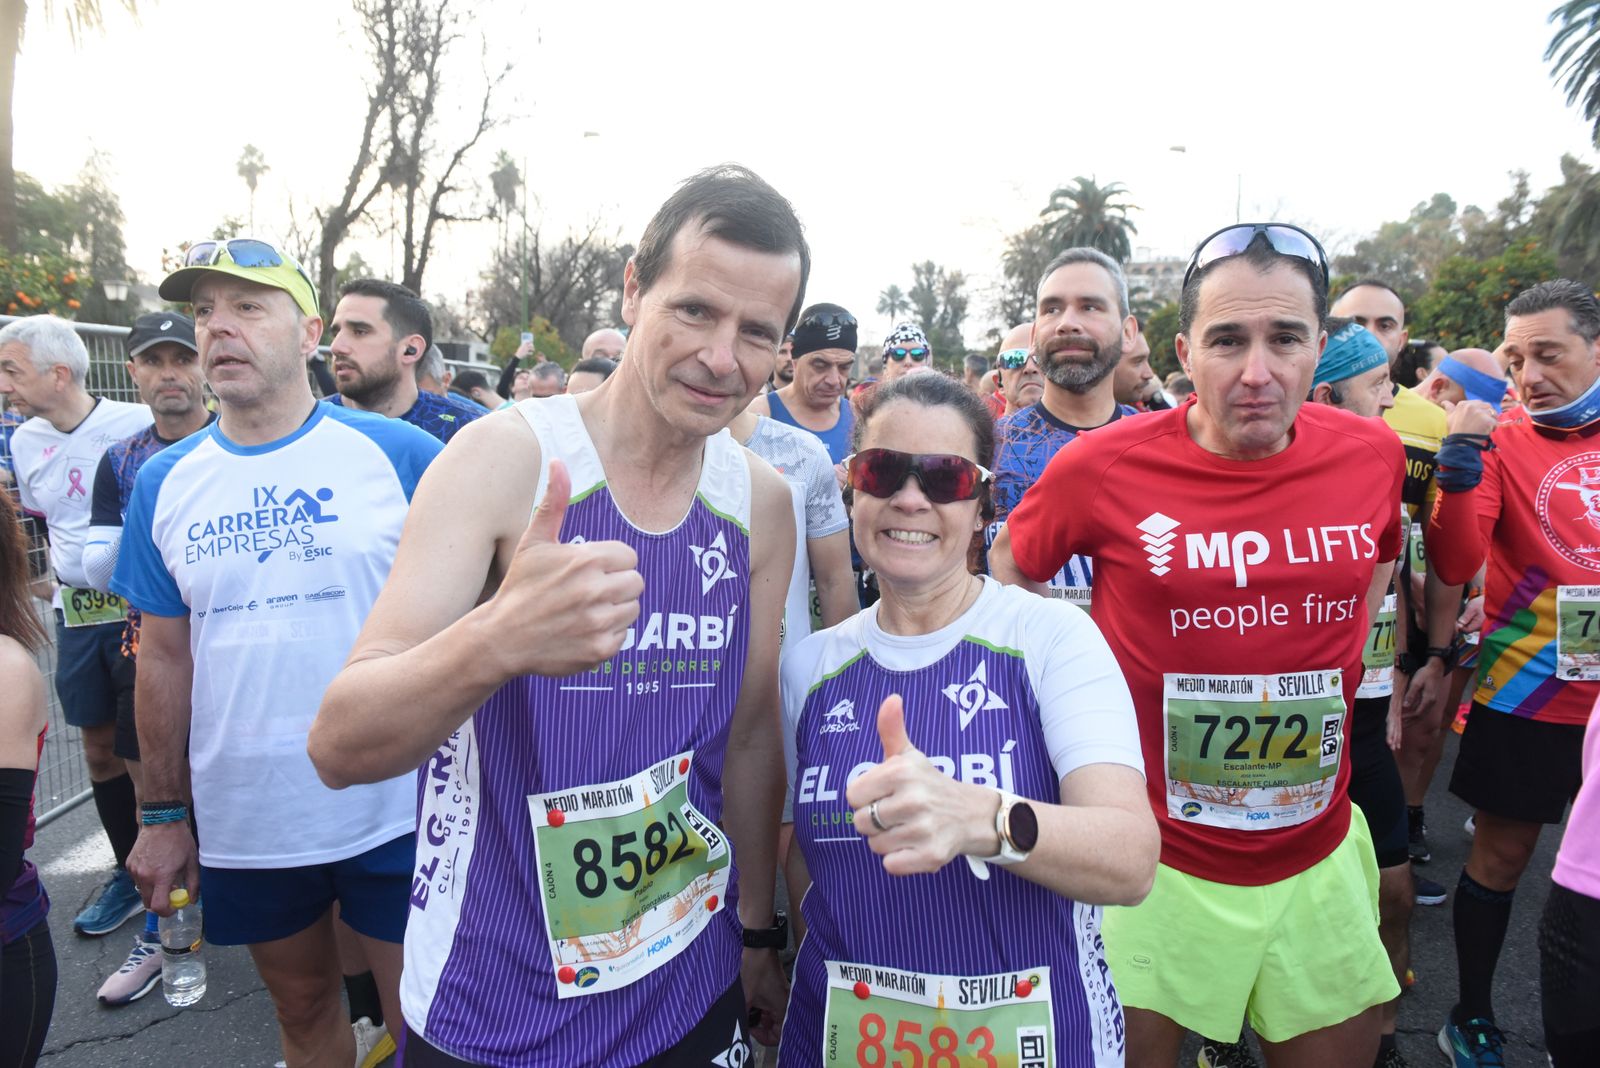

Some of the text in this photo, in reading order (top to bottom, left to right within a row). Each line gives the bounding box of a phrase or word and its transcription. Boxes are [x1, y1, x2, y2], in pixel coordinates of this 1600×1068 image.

[253, 485, 279, 508] IX
[187, 504, 309, 542] CARRERA
[185, 524, 315, 565] EMPRESAS
[289, 551, 302, 562] By
[1283, 523, 1376, 565] LIFTS
[1170, 594, 1358, 637] people first
[1577, 610, 1600, 637] 7
[622, 661, 646, 674] DE
[1177, 674, 1325, 697] MEDIO MARATÓN SEVILLA
[626, 681, 660, 695] 1995
[1194, 714, 1309, 760] 7272
[798, 765, 838, 803] EL
[1217, 779, 1262, 787] ESCALANTE
[1223, 762, 1282, 771] Escalante-MP
[543, 760, 675, 815] MEDIO MARATÓN SEVILLA
[458, 795, 473, 836] 1995
[1246, 811, 1270, 821] HOKA
[573, 811, 697, 899] 8582
[410, 856, 440, 911] EL
[641, 891, 671, 912] González
[647, 934, 673, 958] HOKA
[839, 965, 1019, 1005] MEDIO MARATÓN SEVILLA
[856, 1012, 998, 1068] 8583
